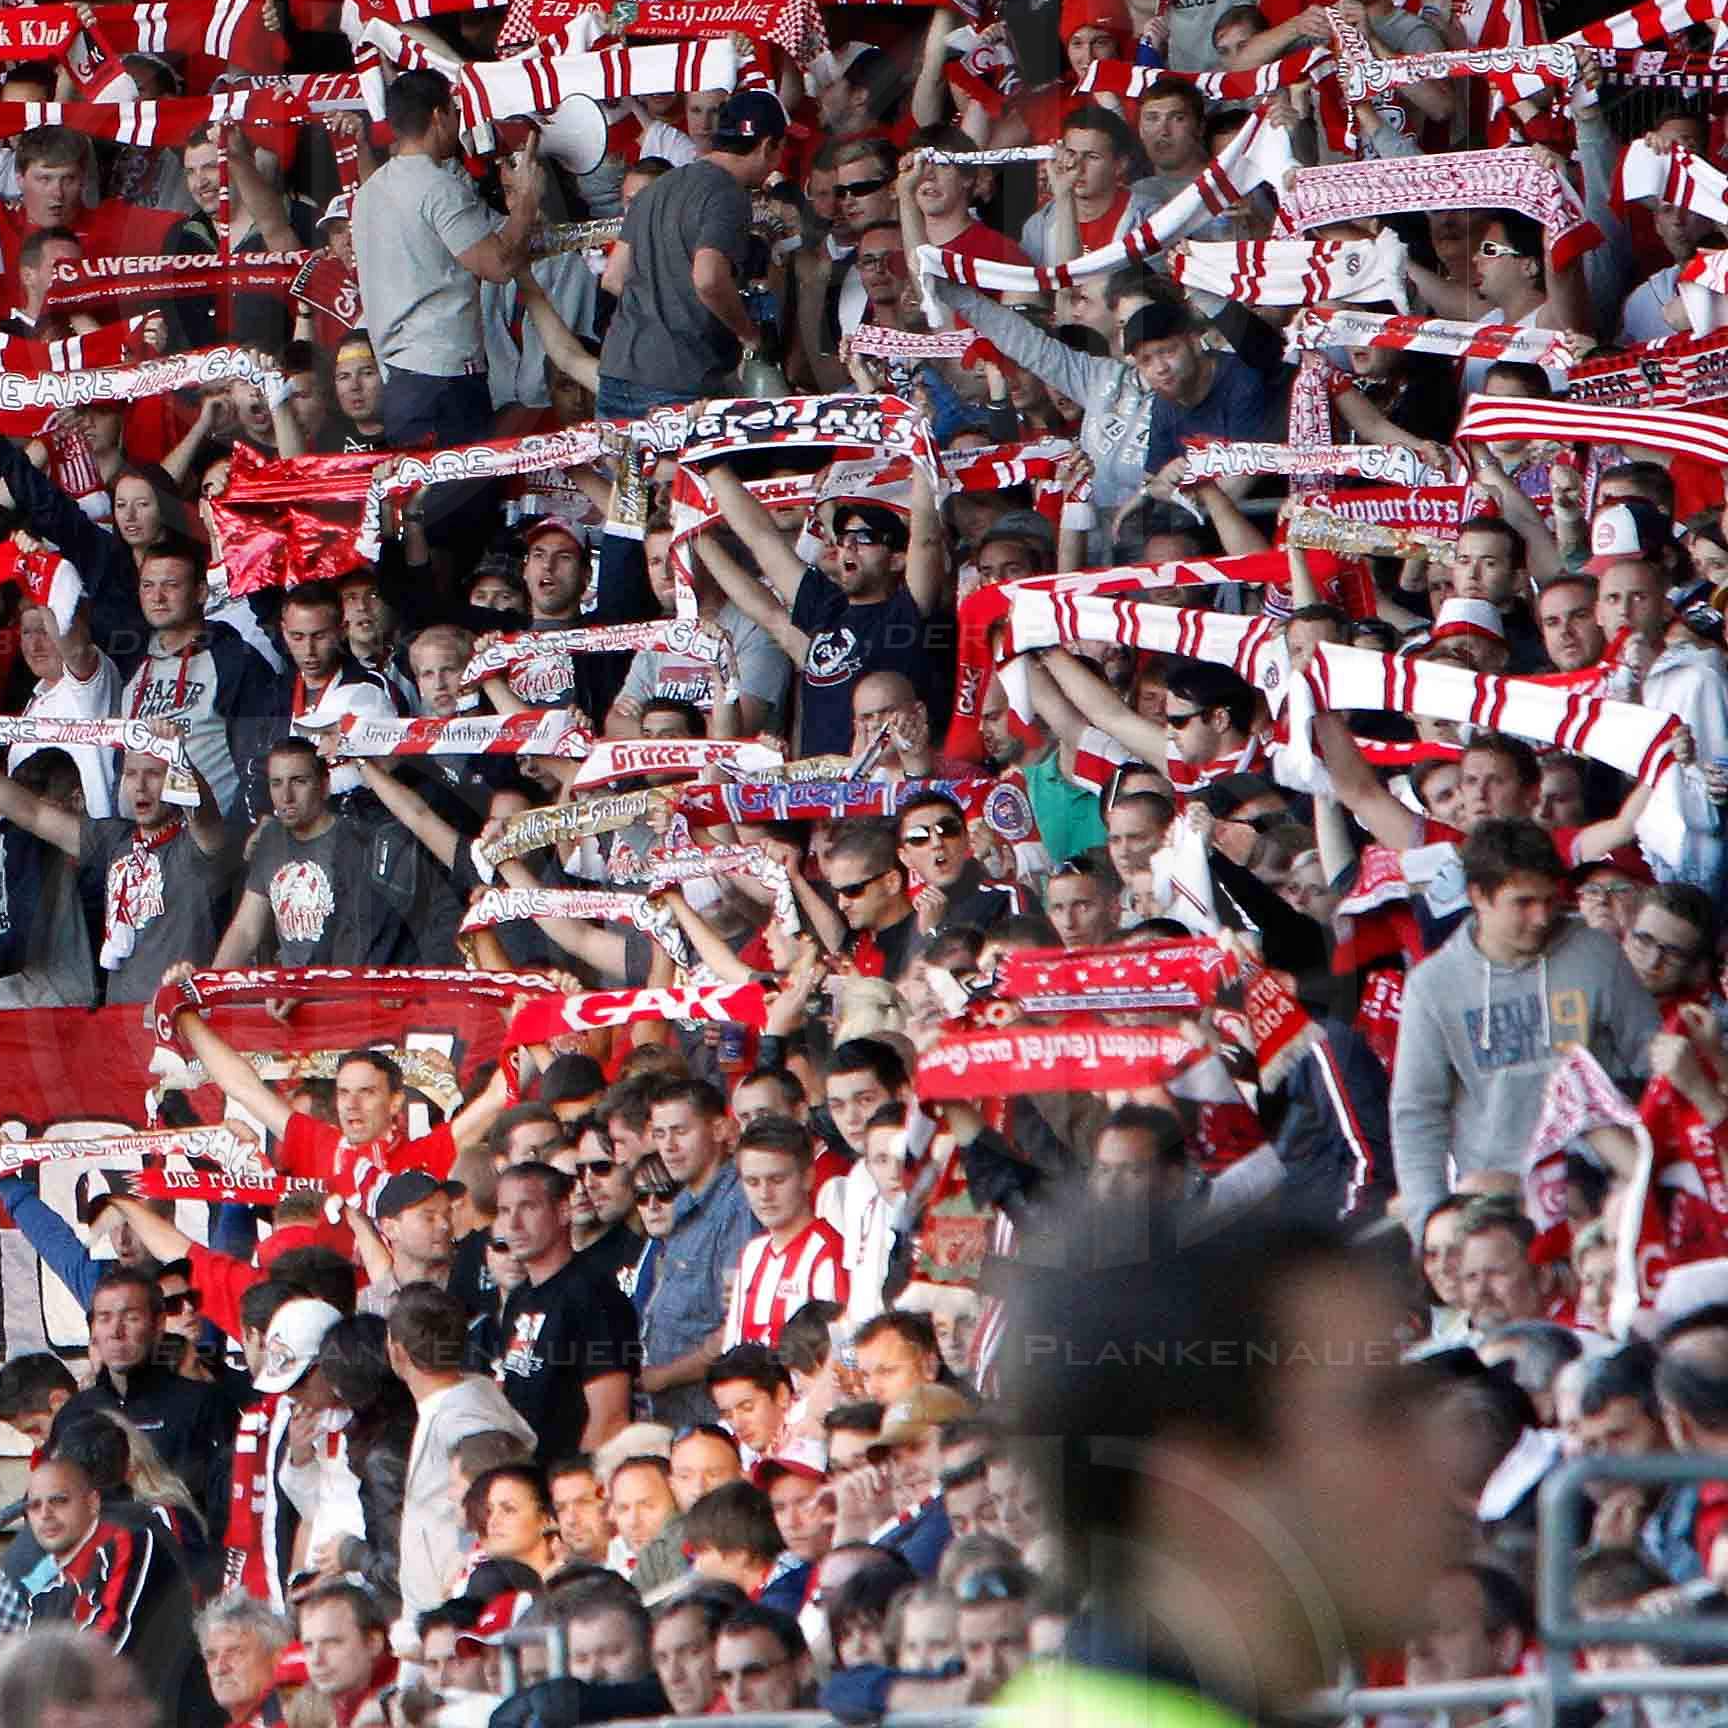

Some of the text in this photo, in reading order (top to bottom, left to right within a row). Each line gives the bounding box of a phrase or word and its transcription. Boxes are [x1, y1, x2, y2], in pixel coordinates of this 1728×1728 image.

[19, 17, 71, 46] Klub
[86, 254, 228, 278] LIVERPOOL
[34, 371, 115, 406] ARE
[398, 446, 495, 485] ARE
[1312, 492, 1460, 526] Supporters
[560, 982, 746, 1033] GAK
